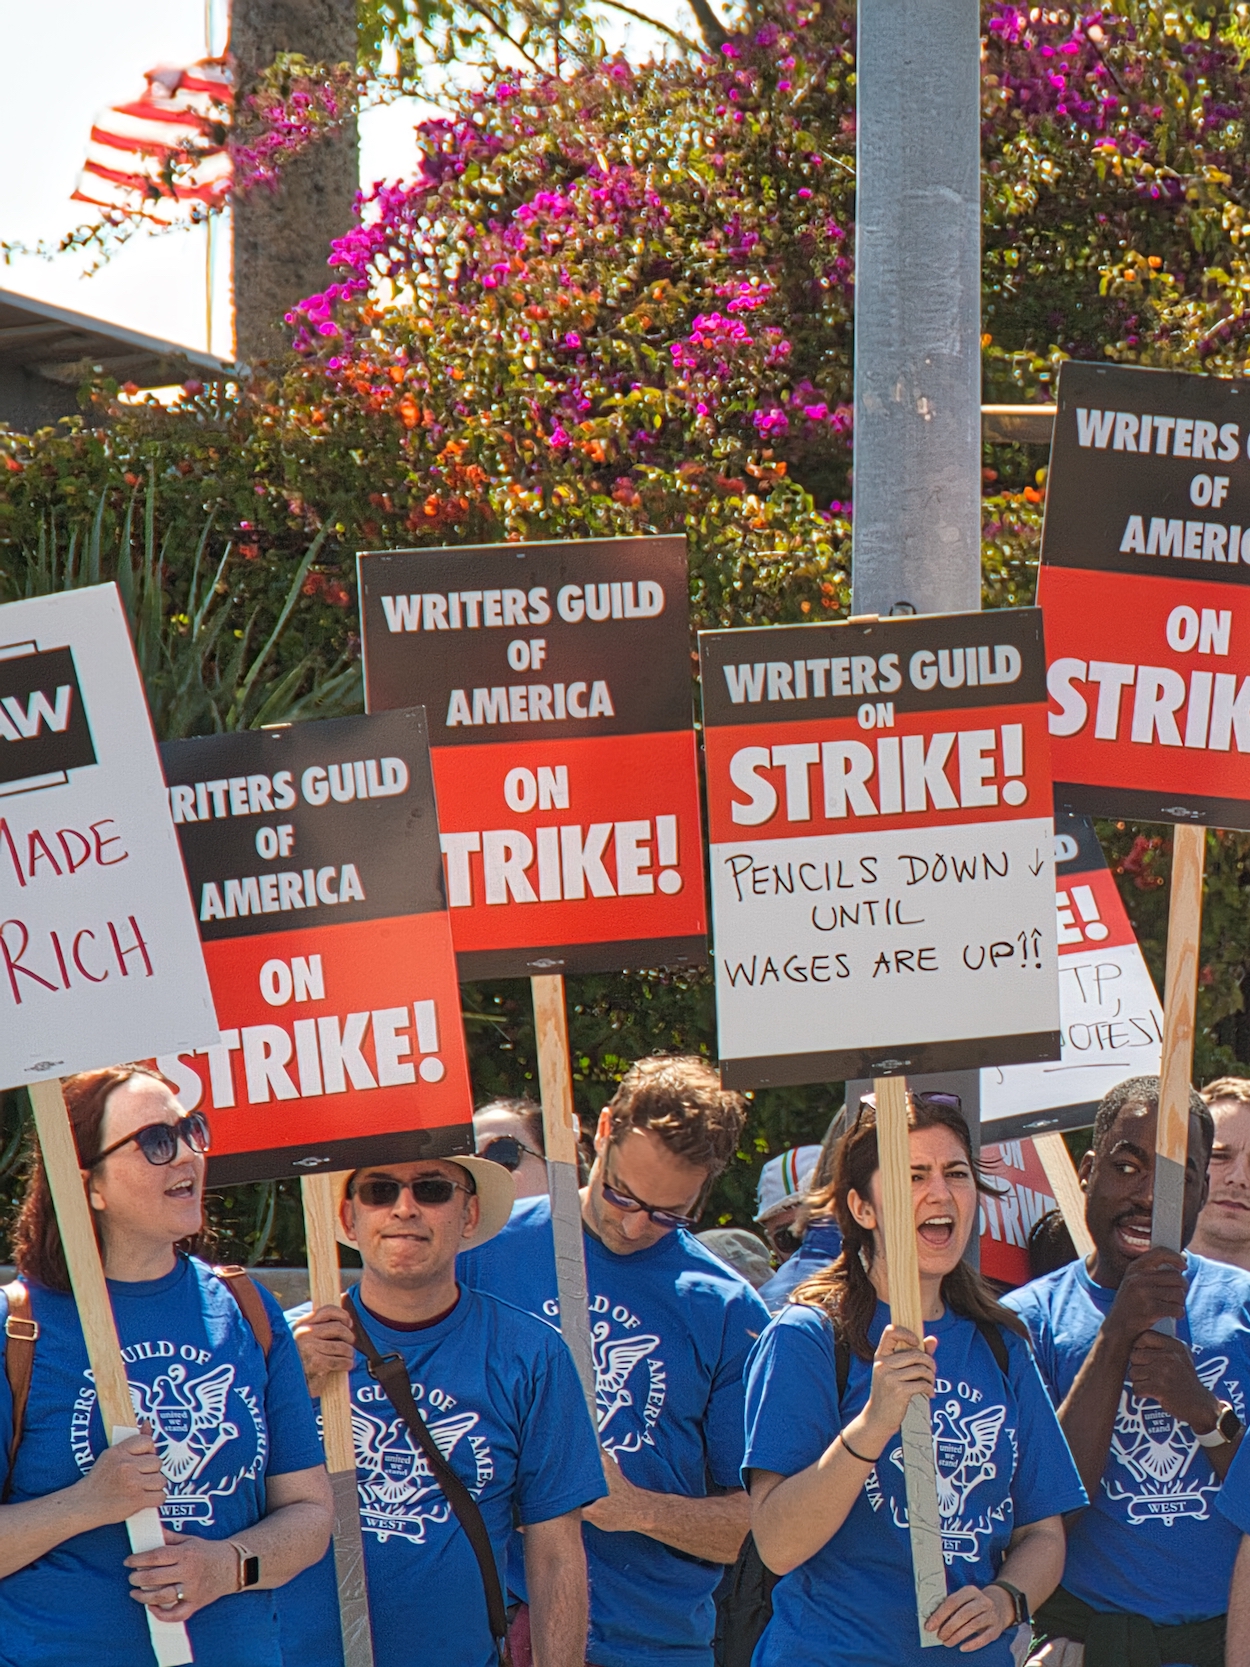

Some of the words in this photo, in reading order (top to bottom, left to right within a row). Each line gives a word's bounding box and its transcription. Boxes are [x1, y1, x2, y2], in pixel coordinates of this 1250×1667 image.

[1076, 408, 1240, 463] WRITERS
[1190, 474, 1230, 508] OF
[381, 587, 551, 633] WRITERS
[557, 581, 665, 623] GUILD
[1166, 605, 1232, 656] ON
[507, 639, 547, 672] OF
[723, 653, 902, 704] WRITERS
[909, 644, 1022, 690] GUILD
[446, 680, 615, 727] AMERICA
[857, 702, 895, 730] ON
[301, 757, 410, 804] GUILD
[503, 765, 570, 814] ON
[728, 724, 1028, 827] STRIKE!
[256, 825, 296, 859] OF
[439, 814, 683, 908] TRIKE!
[200, 864, 366, 922] AMERICA
[725, 854, 878, 902] PENCILS
[898, 851, 1009, 887] DOWN
[811, 898, 925, 931] UNTIL
[0, 915, 154, 1004] RICH
[259, 954, 326, 1006] ON
[724, 953, 851, 988] WAGES
[873, 947, 939, 978] ARE
[1061, 1009, 1163, 1051] OTES!
[156, 999, 445, 1111] STRIKE!
[612, 1306, 641, 1329] OF
[121, 1341, 174, 1365] UILD
[180, 1345, 211, 1365] OF
[357, 1383, 424, 1402] GUD
[429, 1389, 456, 1412] OF
[641, 1359, 666, 1445] AMERA
[957, 1382, 983, 1404] OF
[159, 1411, 188, 1420] united
[164, 1425, 188, 1433] stand
[234, 1386, 268, 1480] AMERICA
[160, 1504, 195, 1516] WEST
[366, 1517, 406, 1531] WEST
[1148, 1501, 1186, 1513] WEST
